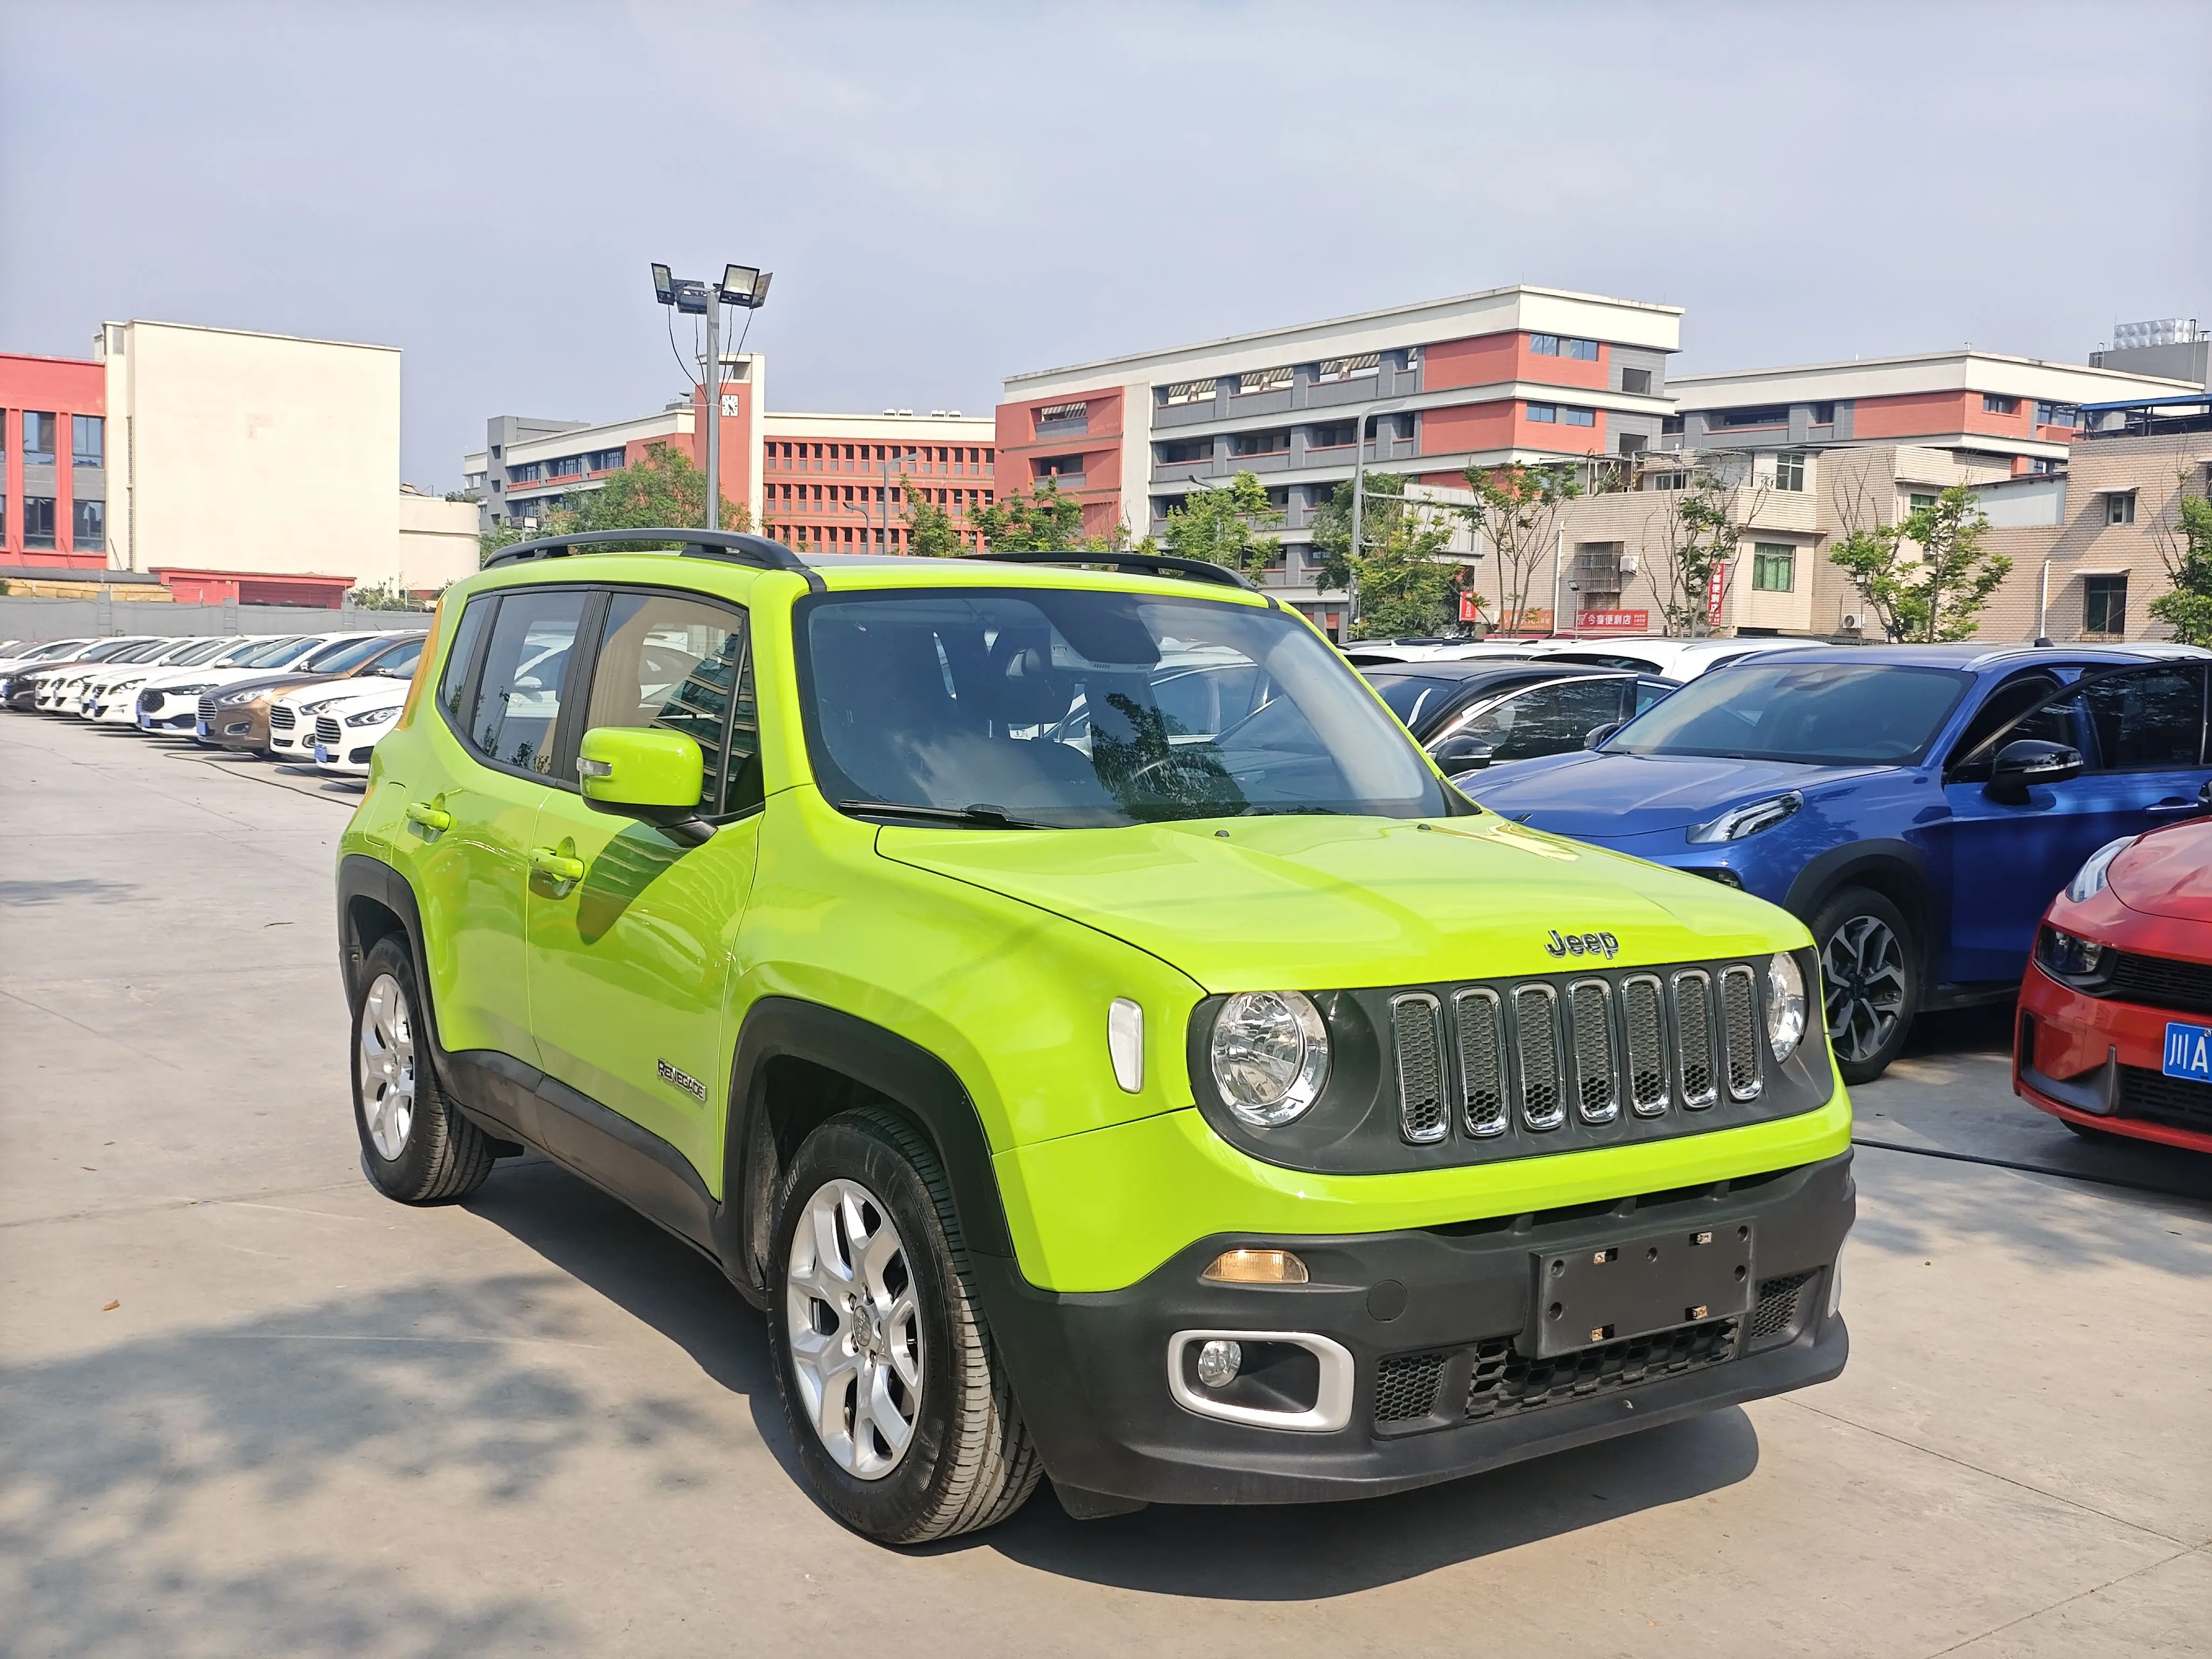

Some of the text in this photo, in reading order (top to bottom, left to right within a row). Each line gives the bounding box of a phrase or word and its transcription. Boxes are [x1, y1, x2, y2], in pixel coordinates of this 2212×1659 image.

[1588, 614, 1631, 625] 今喜便利店
[1545, 929, 1619, 960] Jeep
[2169, 1033, 2208, 1073] 川A
[657, 1057, 706, 1102] RENEGADE
